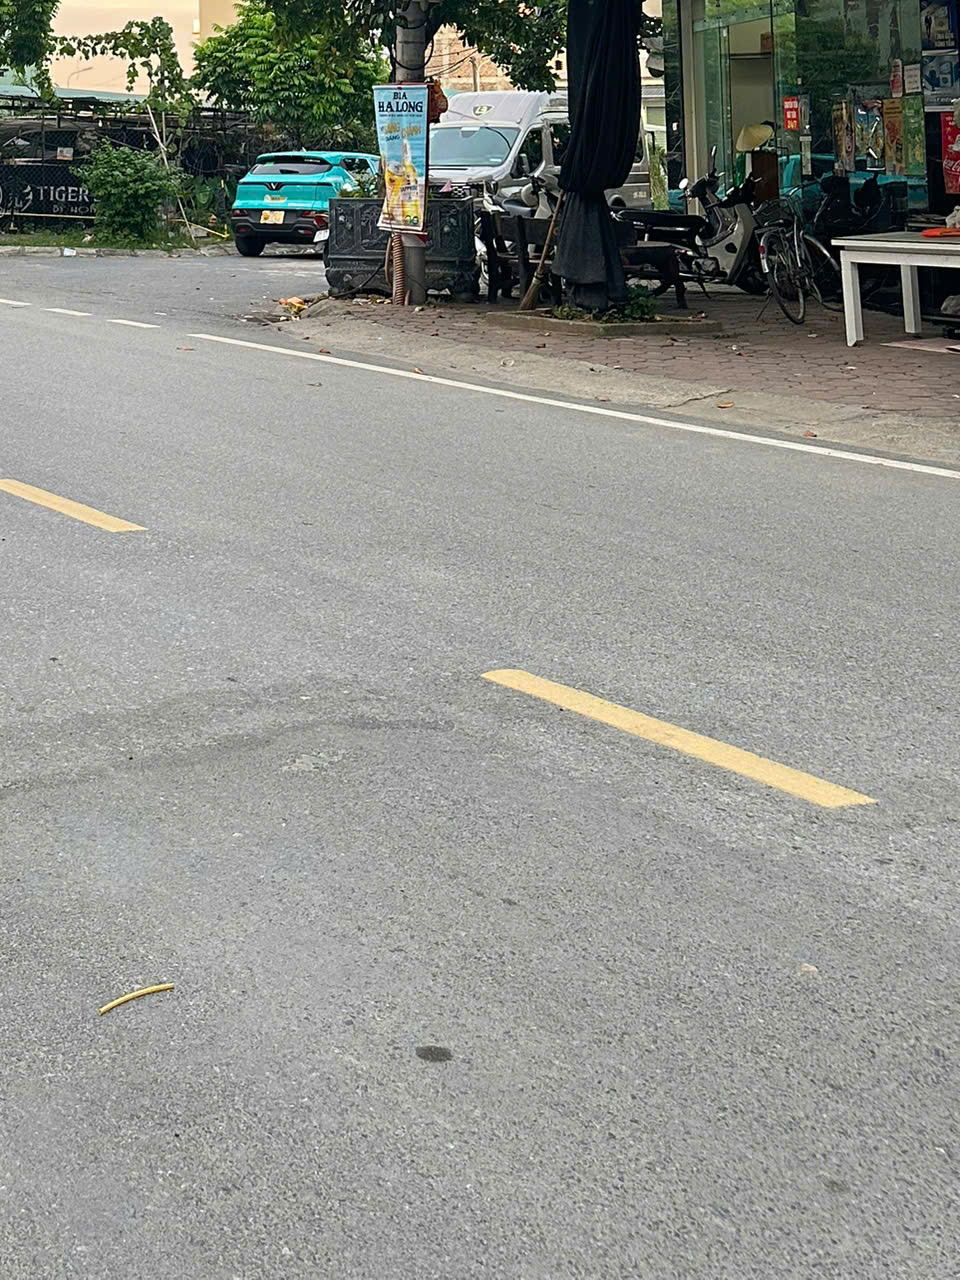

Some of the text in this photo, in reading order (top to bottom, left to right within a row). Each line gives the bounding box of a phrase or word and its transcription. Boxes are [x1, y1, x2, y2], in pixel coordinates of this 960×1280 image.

[393, 91, 408, 100] BIA
[395, 101, 423, 112] LONG
[37, 185, 89, 202] TIGER
